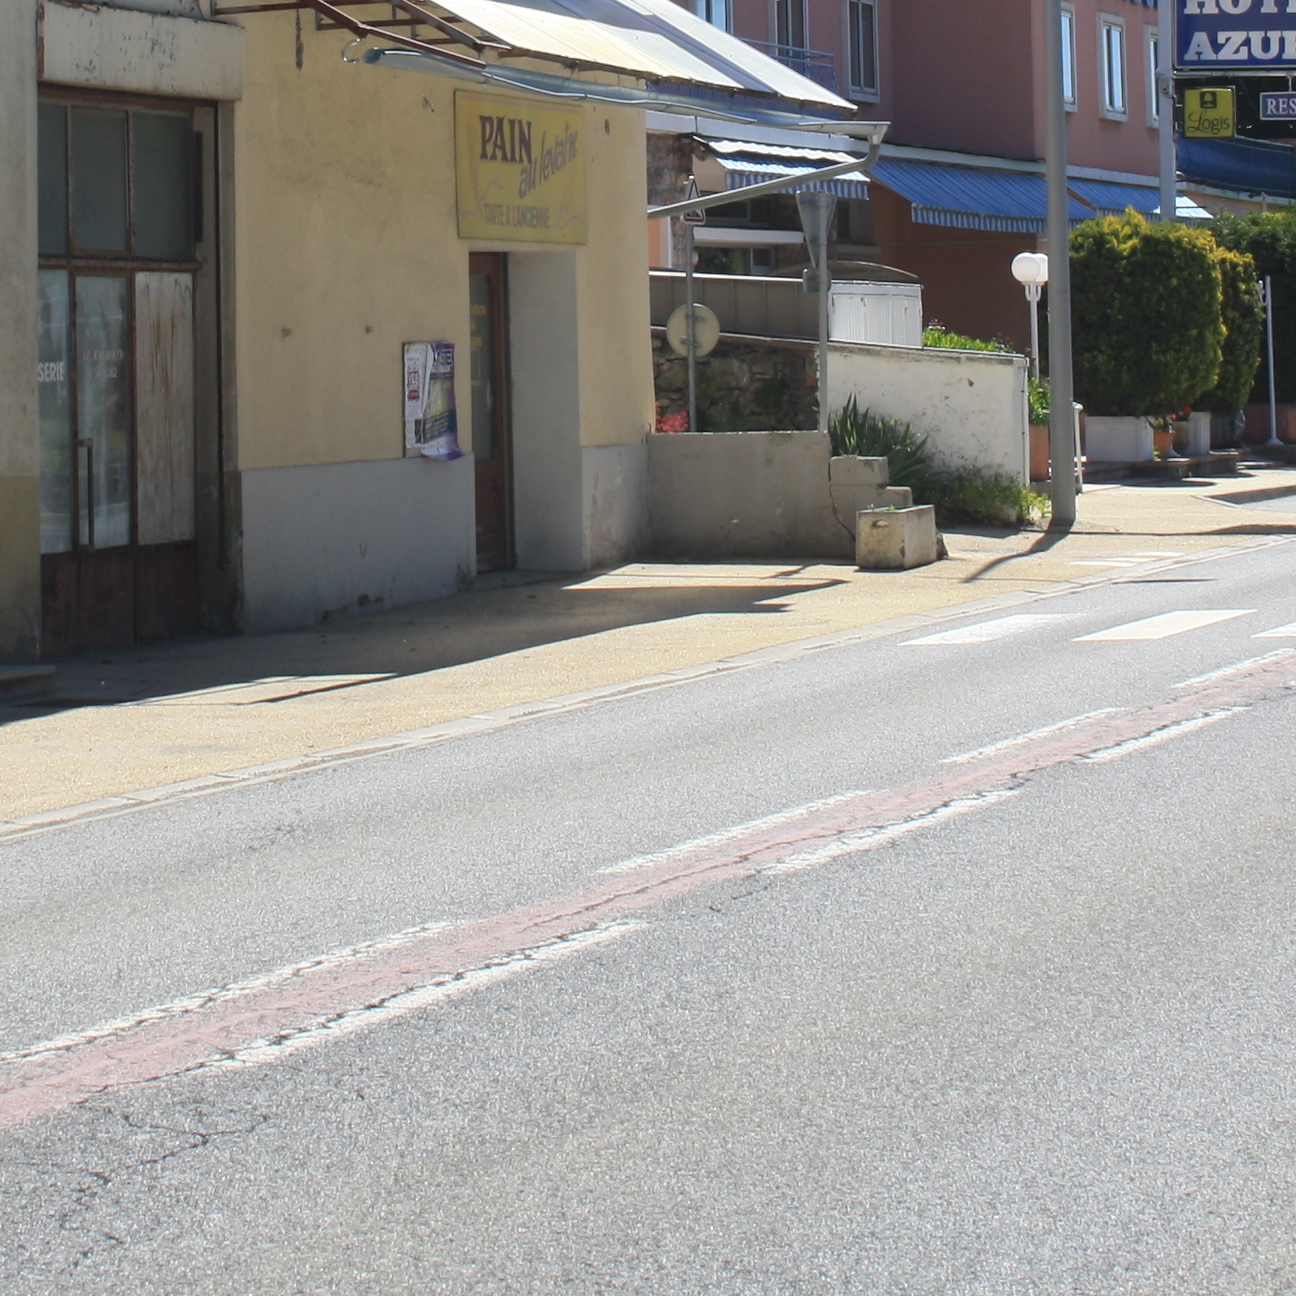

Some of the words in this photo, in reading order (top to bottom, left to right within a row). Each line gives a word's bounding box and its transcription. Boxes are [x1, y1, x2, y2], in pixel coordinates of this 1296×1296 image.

[1186, 111, 1231, 135] Logis
[479, 114, 533, 164] PAIN
[38, 361, 64, 383] SERIE
